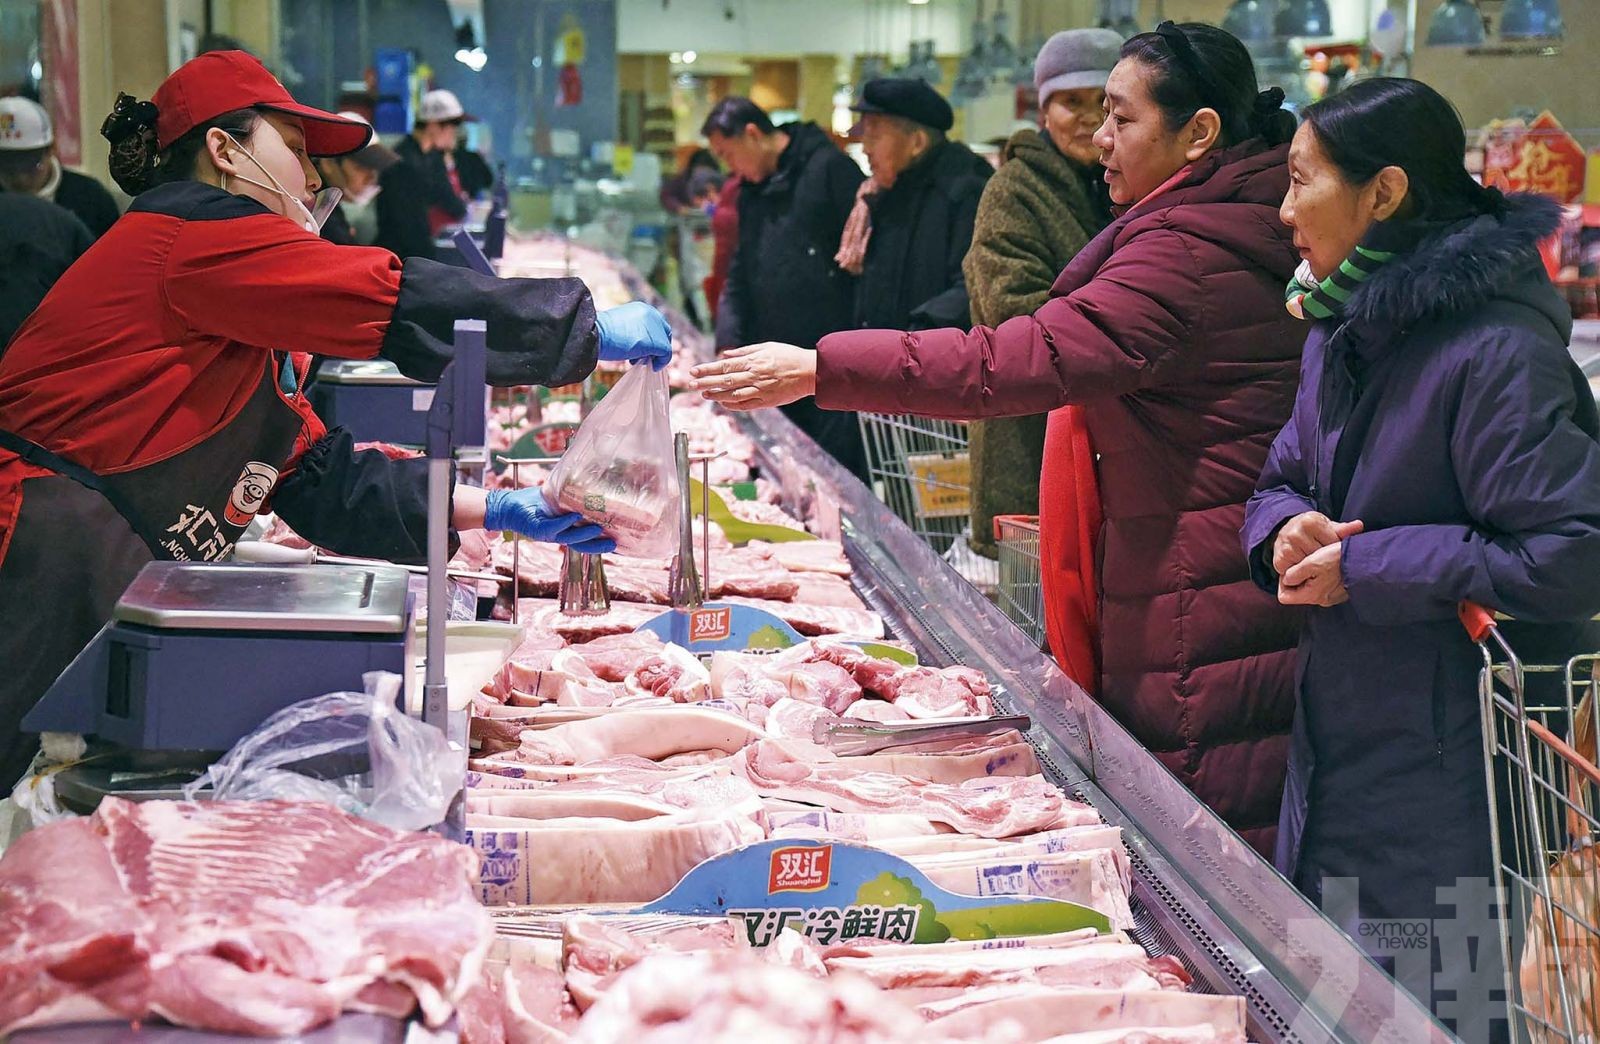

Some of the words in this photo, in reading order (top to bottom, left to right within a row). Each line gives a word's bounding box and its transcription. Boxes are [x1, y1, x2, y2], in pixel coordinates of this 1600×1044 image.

[694, 611, 726, 633] 双汇
[776, 851, 824, 880] 双汇
[776, 876, 822, 887] Shuanghui
[729, 907, 917, 947] 双汇冷鲜肉
